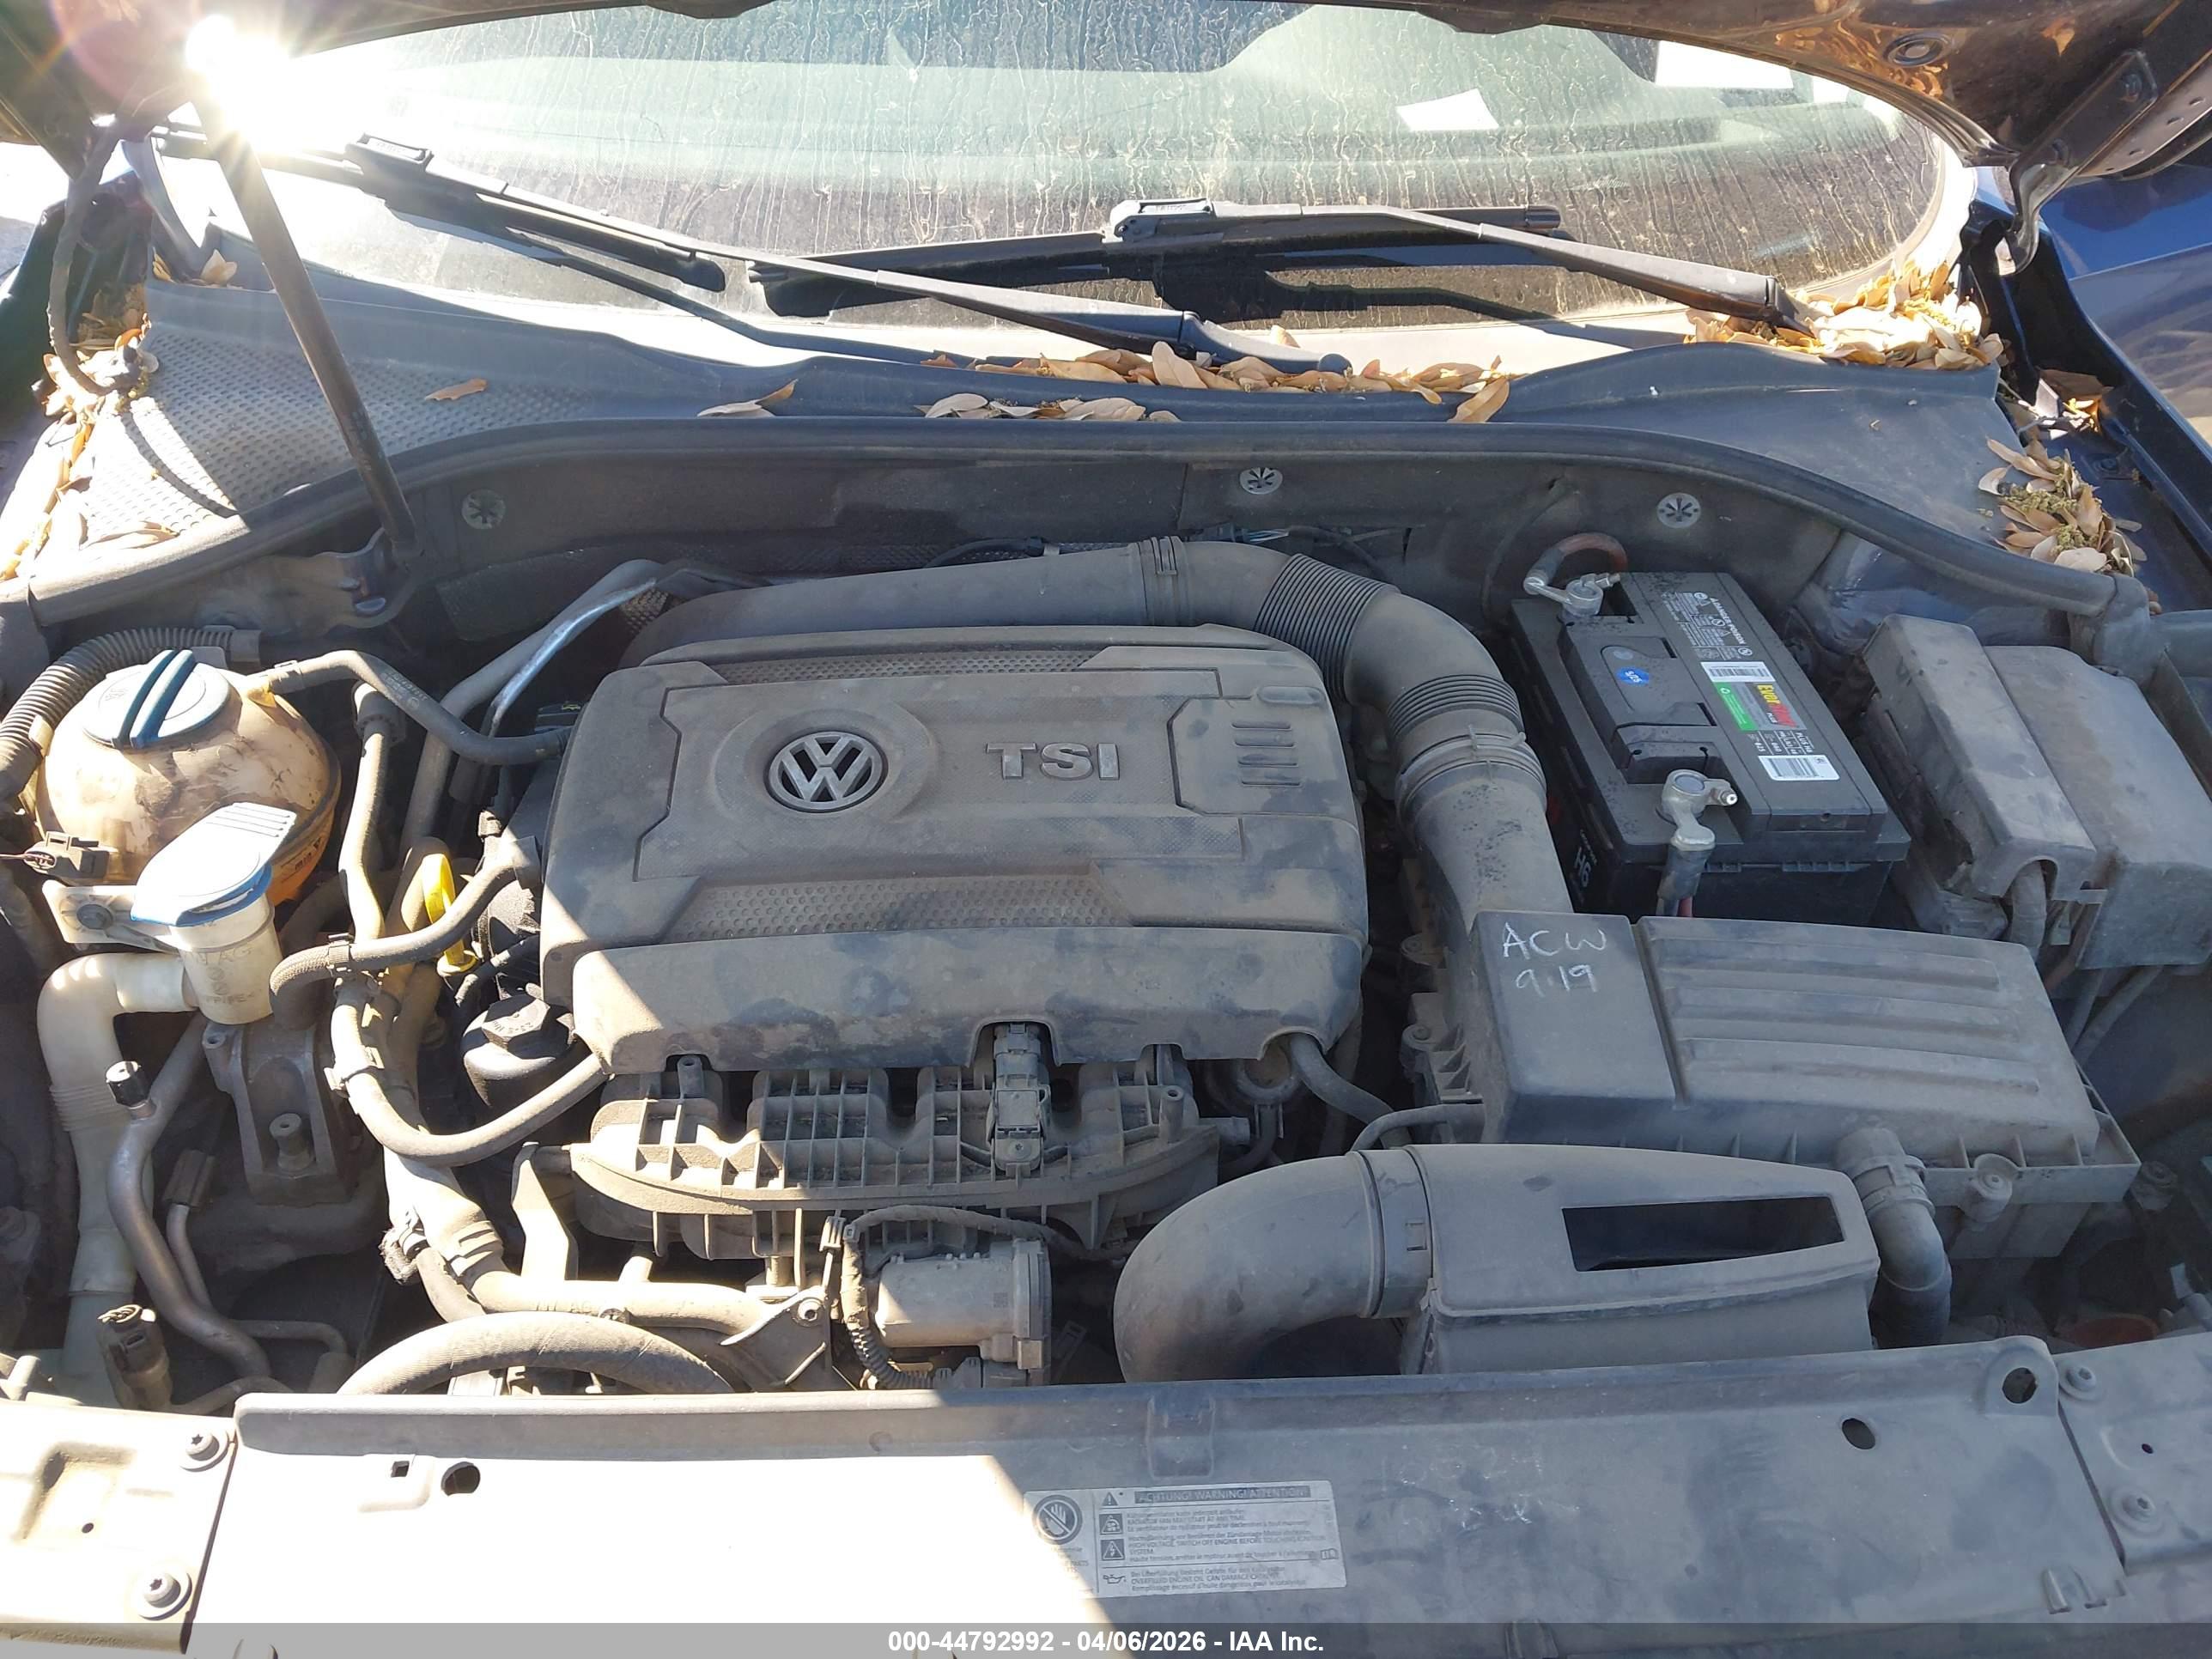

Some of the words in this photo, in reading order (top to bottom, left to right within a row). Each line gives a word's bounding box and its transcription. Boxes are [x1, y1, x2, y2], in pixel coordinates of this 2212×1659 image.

[986, 742, 1121, 781] TSI
[1574, 847, 1591, 887] H6
[1503, 922, 1607, 959] ACW
[1194, 1488, 1247, 1500] WARNING!
